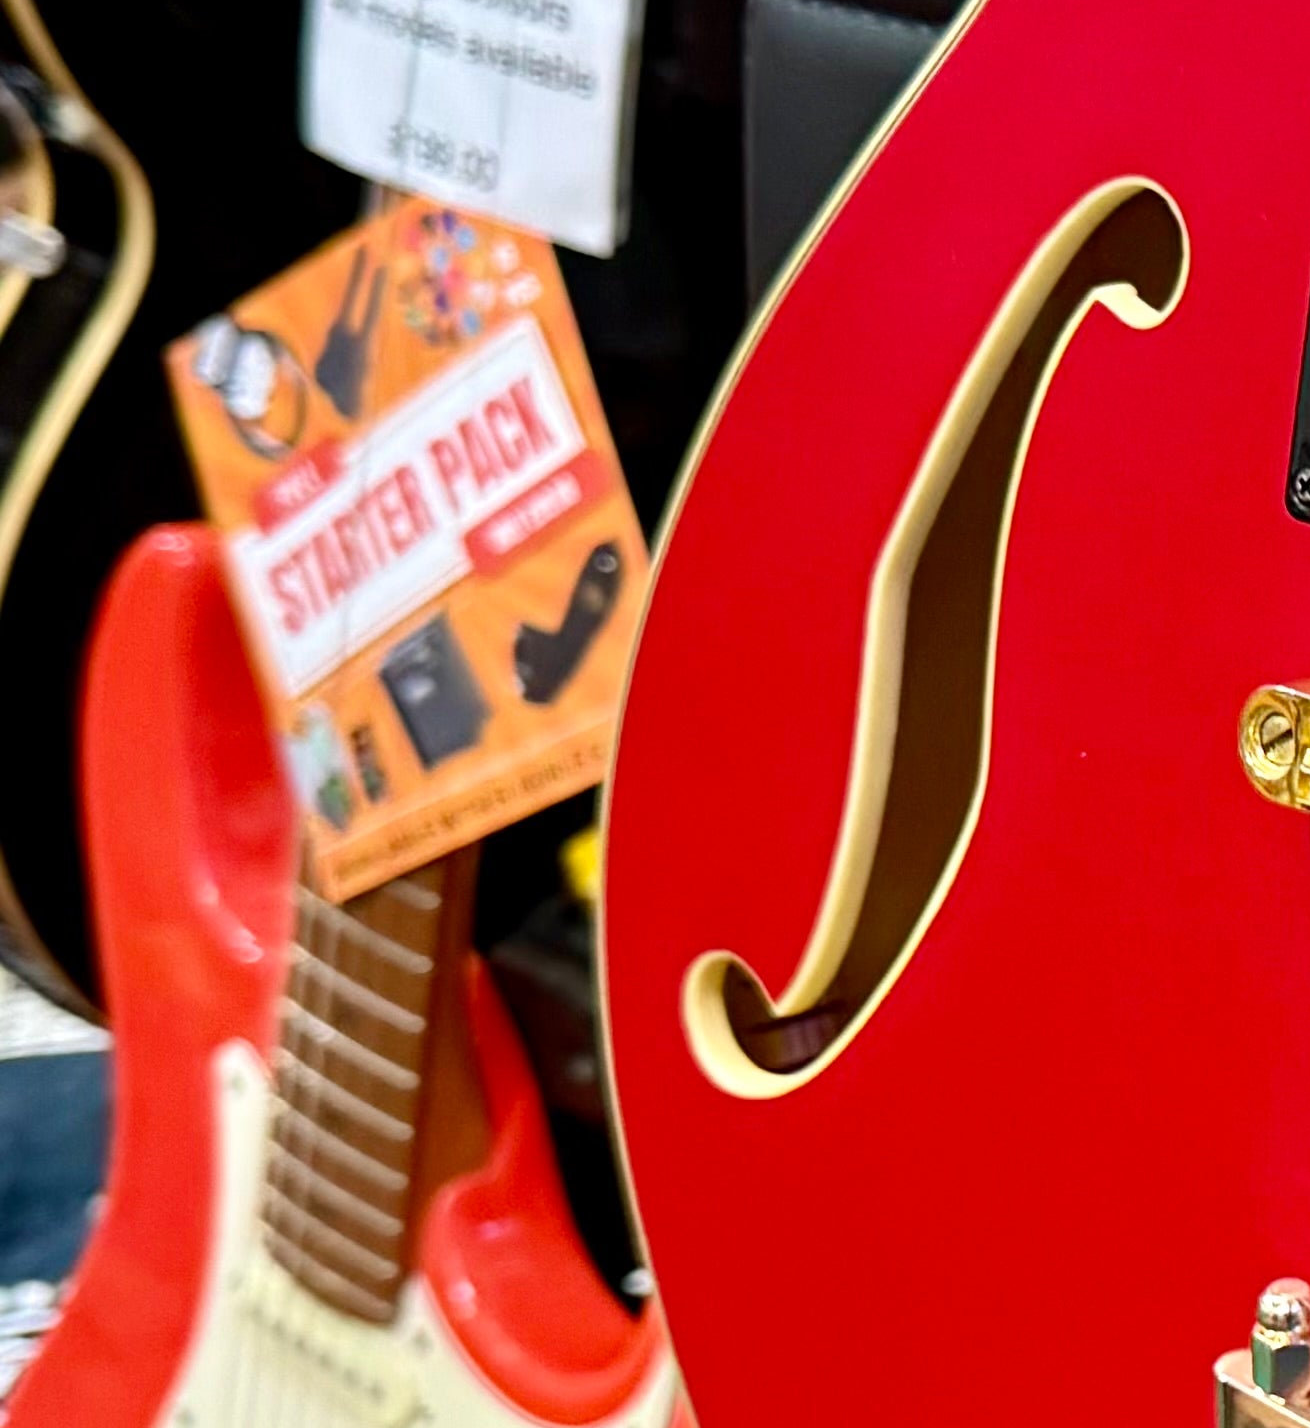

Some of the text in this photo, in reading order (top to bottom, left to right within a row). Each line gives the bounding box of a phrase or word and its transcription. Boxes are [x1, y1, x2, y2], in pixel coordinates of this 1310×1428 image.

[463, 26, 599, 102] available
[268, 464, 438, 635] STARTER
[430, 375, 553, 515] PACK
